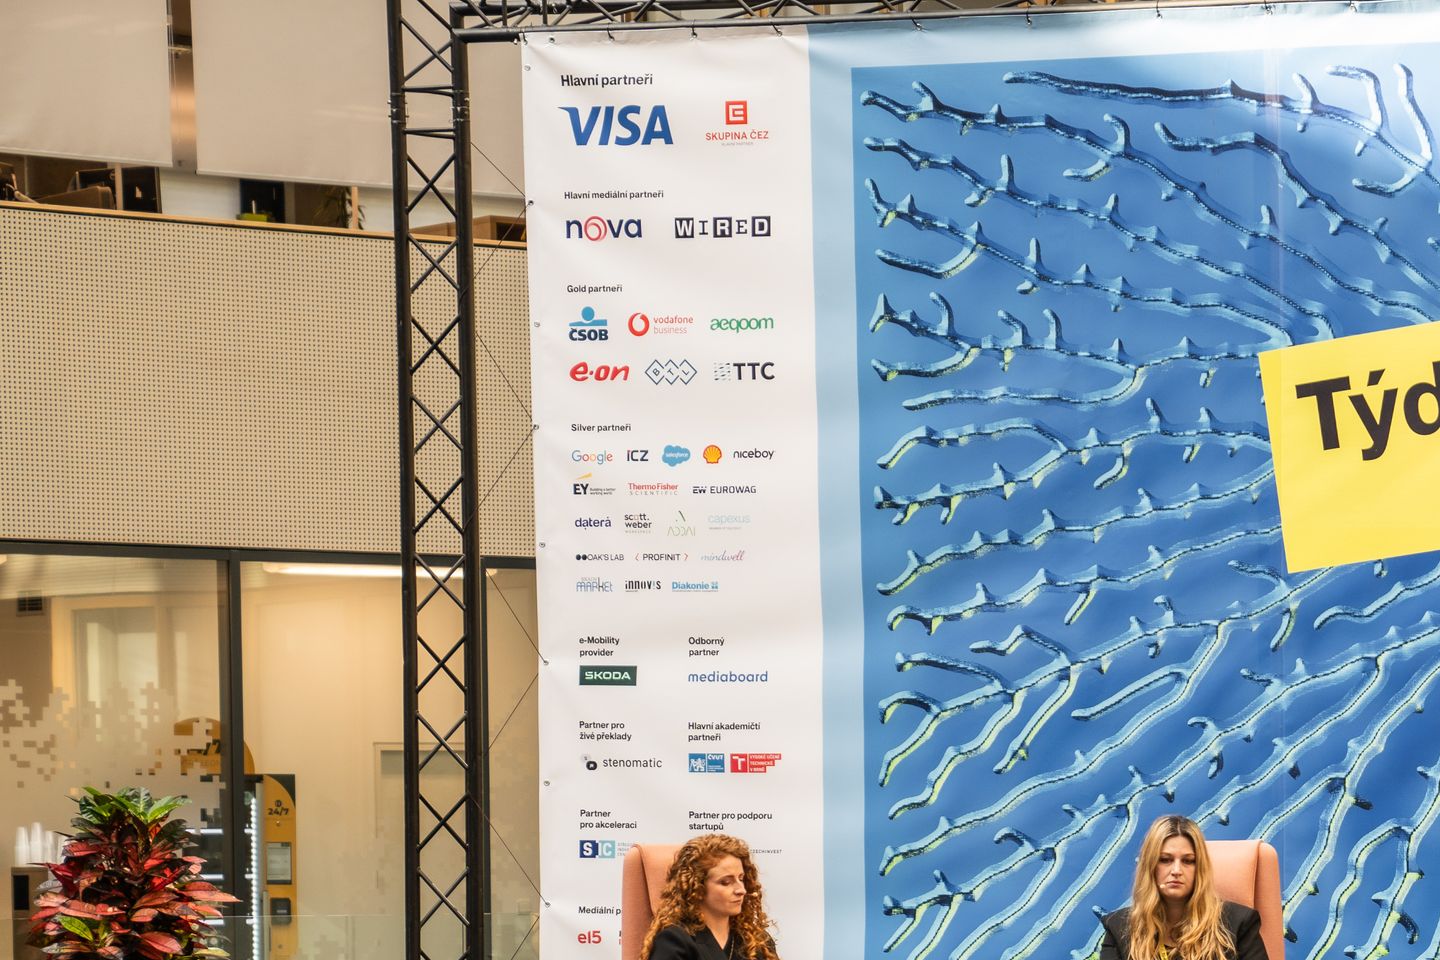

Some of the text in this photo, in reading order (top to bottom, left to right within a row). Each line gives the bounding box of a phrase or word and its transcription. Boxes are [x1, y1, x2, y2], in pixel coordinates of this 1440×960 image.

[561, 74, 653, 88] Hlavní partneři
[558, 105, 674, 146] VISA
[705, 129, 769, 141] SKUPINA ČEZ
[564, 190, 664, 200] Hlavní mediální partneři
[566, 215, 642, 242] nova
[675, 216, 771, 239] WIRED
[567, 284, 623, 294] Gold partneři
[653, 315, 694, 324] vodafone
[653, 326, 688, 334] business
[710, 318, 774, 333] aeqoom
[569, 328, 609, 341] ČSOB
[733, 362, 775, 380] TTC
[571, 423, 631, 432] Silver partneři
[571, 450, 613, 465] Google
[733, 448, 774, 460] niceboy
[573, 483, 589, 495] EY
[710, 486, 757, 494] EUROWAG
[625, 521, 652, 529] weber
[642, 553, 681, 561] PROFINIT
[672, 581, 710, 590] Diakonie
[579, 636, 620, 645] e-Mobility
[688, 636, 725, 646] Odborný
[579, 649, 614, 657] provider
[688, 649, 720, 657] partner
[688, 671, 769, 682] mediaboard
[579, 721, 625, 731] Partner pro
[688, 721, 761, 730] Hlavní akademičtí
[579, 731, 632, 741] živé překlady
[688, 733, 721, 742] partneři
[603, 758, 662, 768] stenomatic
[268, 808, 289, 816] 24/7
[689, 811, 720, 819] Partner
[737, 812, 772, 820] podporu
[595, 821, 637, 829] akceleraci
[689, 822, 724, 831] startupů
[578, 906, 614, 914] Mediální
